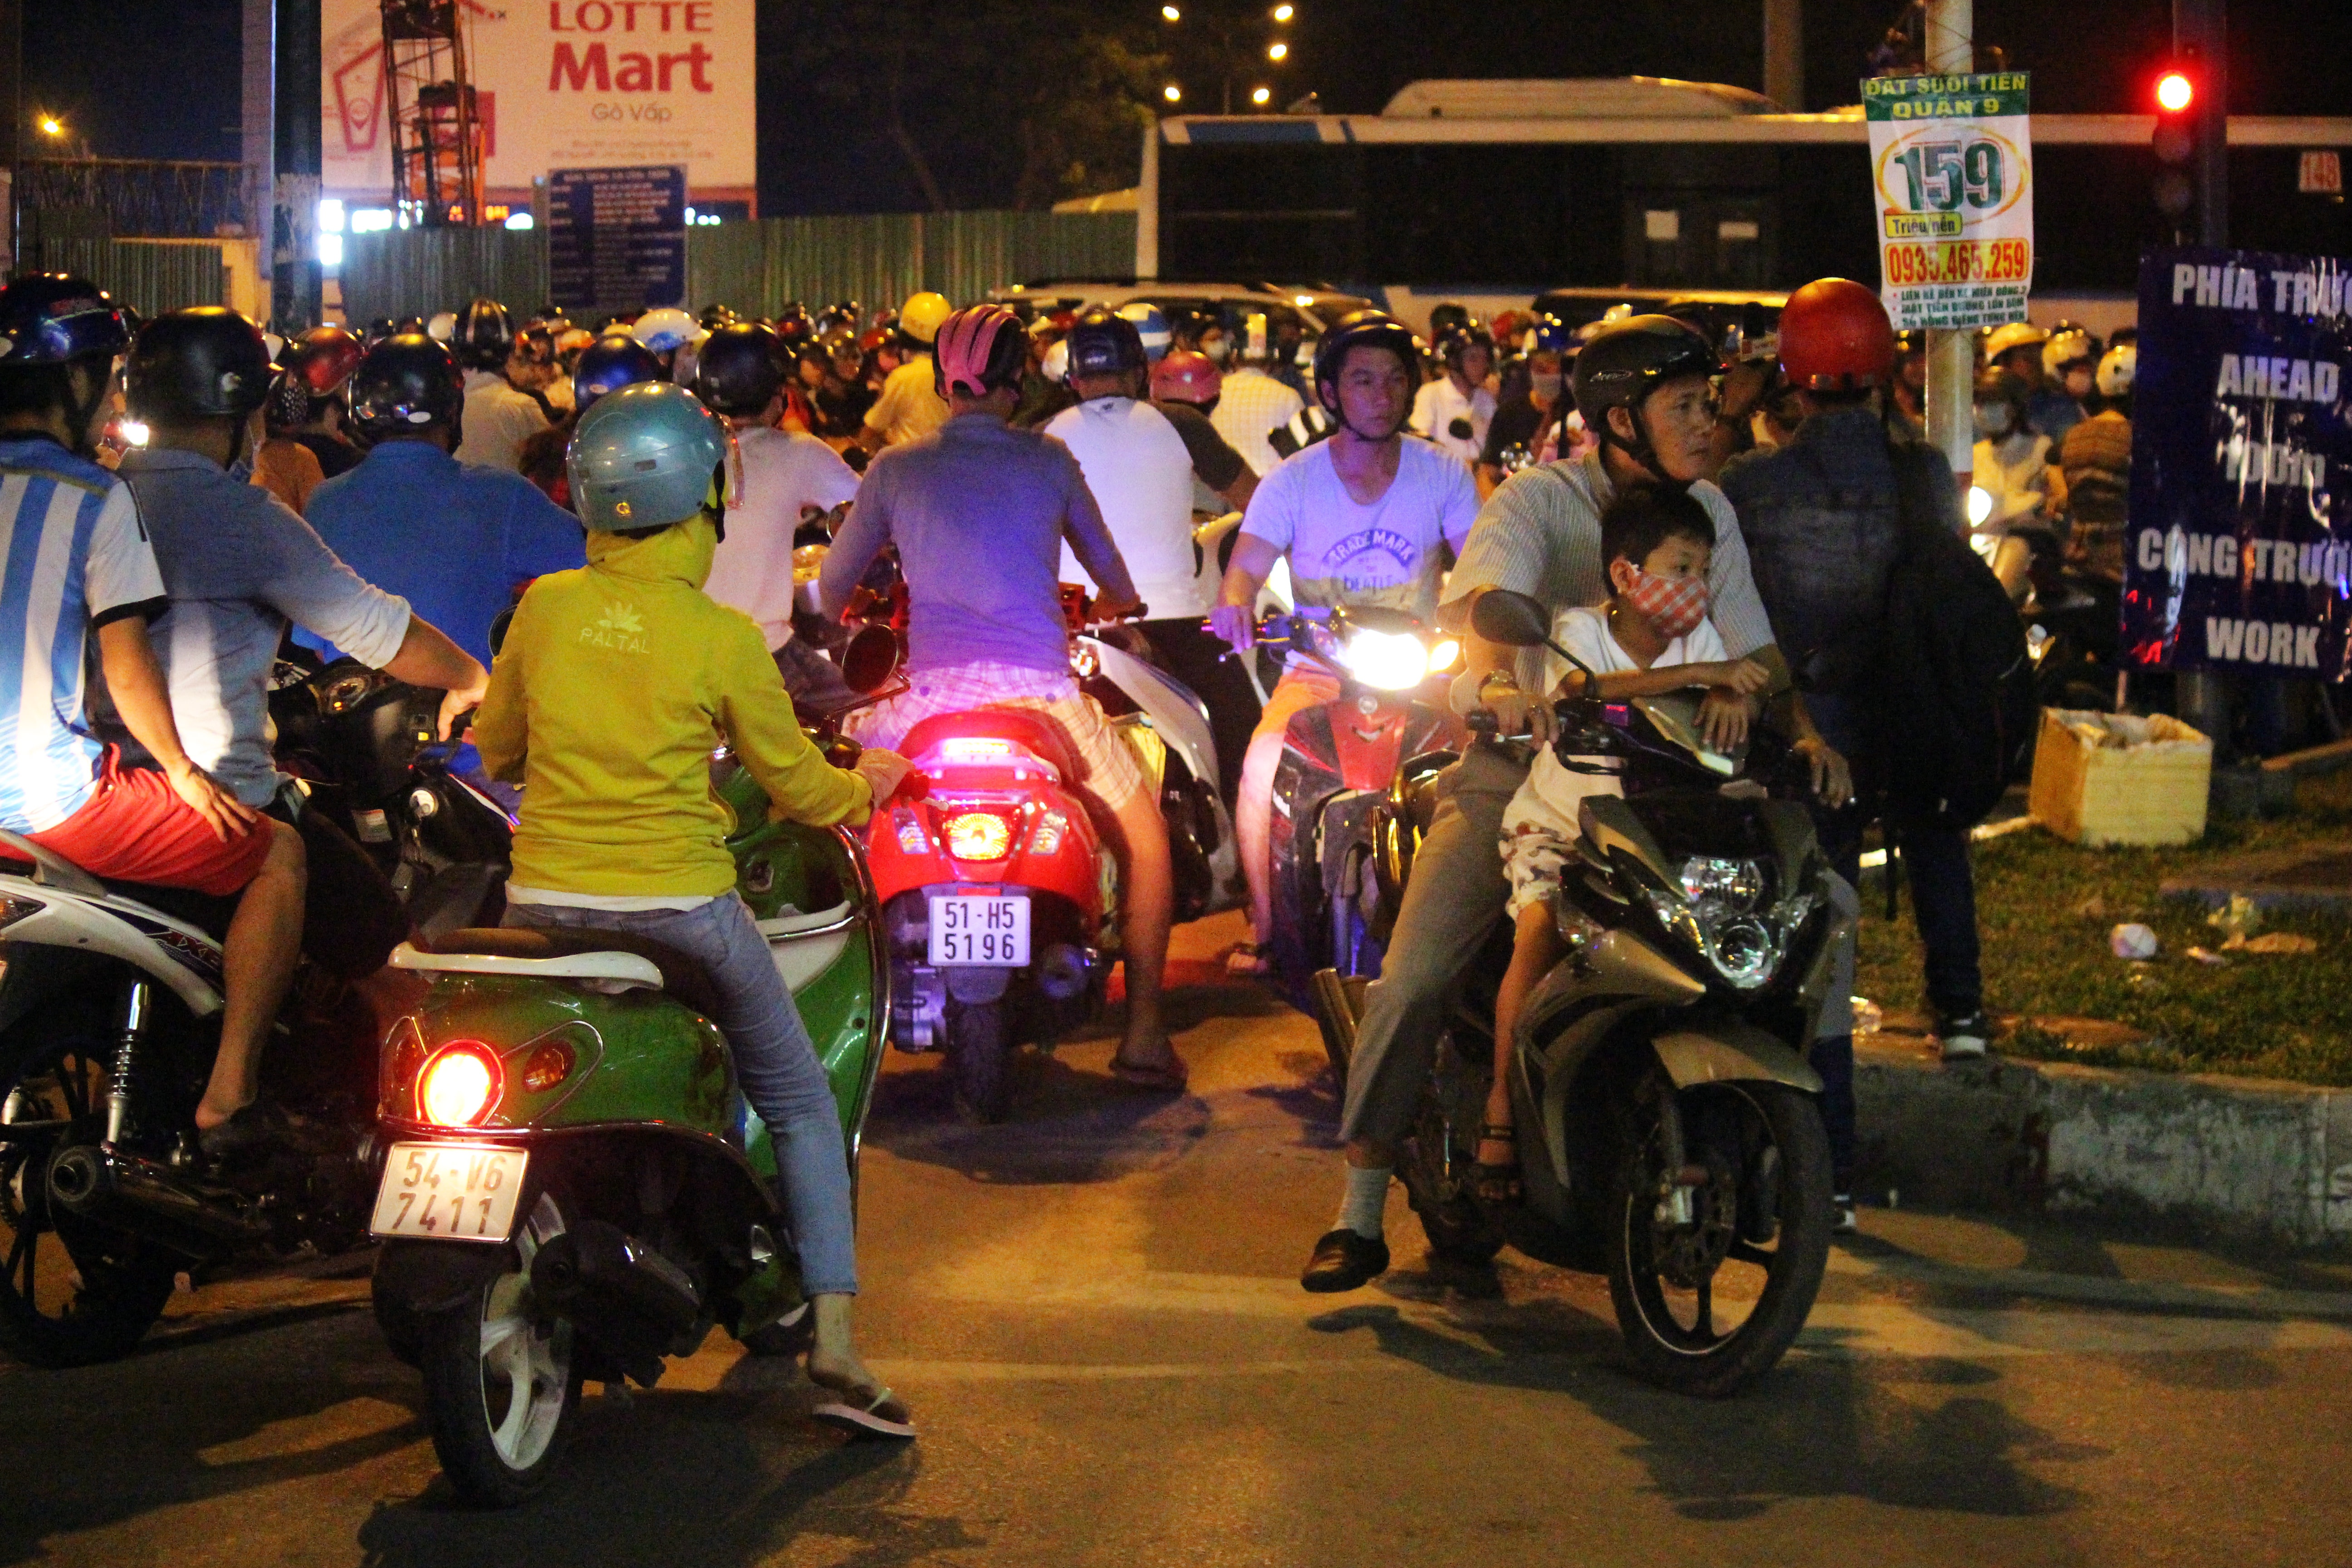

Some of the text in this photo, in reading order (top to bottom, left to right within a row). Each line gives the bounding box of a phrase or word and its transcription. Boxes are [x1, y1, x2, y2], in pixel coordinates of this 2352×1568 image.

[550, 1, 713, 32] LOTTE
[549, 42, 713, 93] Mart
[1983, 98, 1999, 113] 9
[1894, 138, 2005, 211] 159
[1890, 242, 2024, 283] 0935.465.259
[2173, 261, 2352, 317] PHÍA TRƯ
[2217, 354, 2339, 402] AHEAD
[1373, 530, 1414, 560] MARK
[2206, 617, 2318, 668] WORK
[945, 933, 1014, 960] 5196
[392, 1192, 493, 1234] 7411
